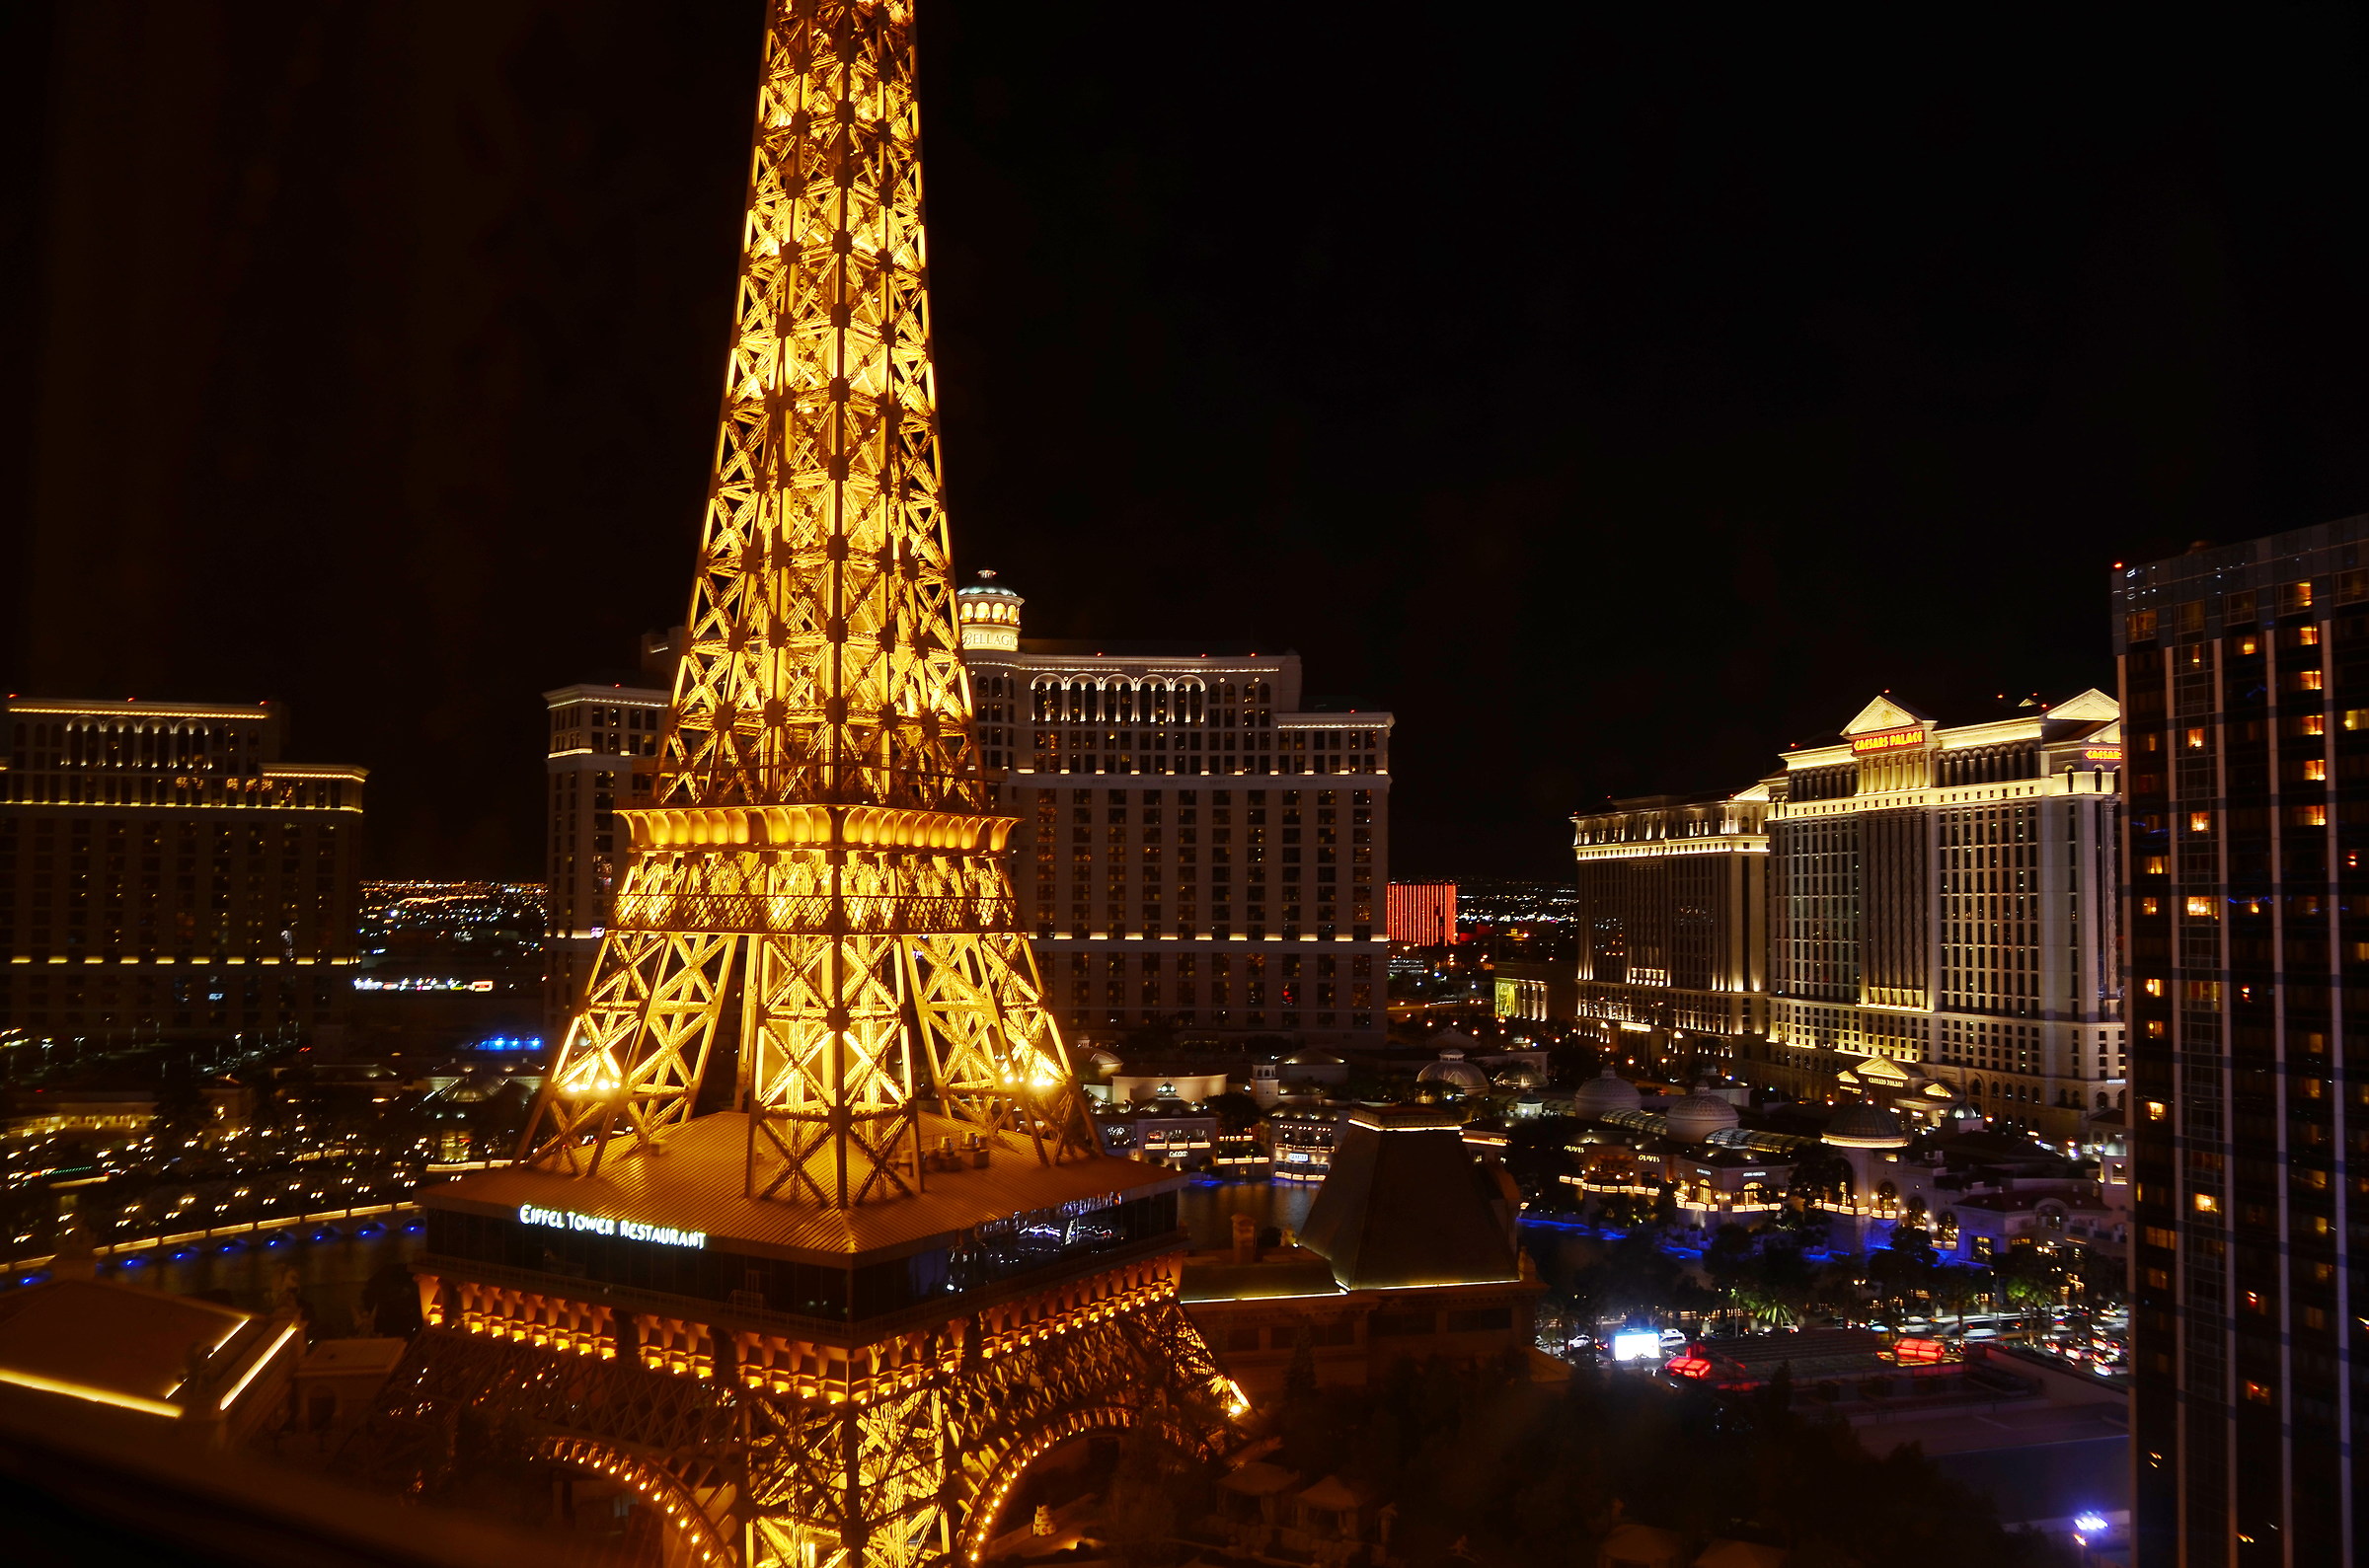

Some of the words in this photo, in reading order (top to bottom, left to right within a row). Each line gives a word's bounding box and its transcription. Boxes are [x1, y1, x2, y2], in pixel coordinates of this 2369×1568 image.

[961, 632, 1019, 647] BELLAGIO
[1854, 735, 1888, 751] CAESARS
[1889, 730, 1923, 746] PALACE
[2085, 750, 2122, 760] CAESAR
[1564, 1145, 1585, 1154] OLIVES
[1638, 1154, 1660, 1163] OLIVES
[519, 1204, 566, 1230] EIFFEL
[566, 1211, 615, 1236] TOWER
[620, 1220, 707, 1250] RESTAURANT
